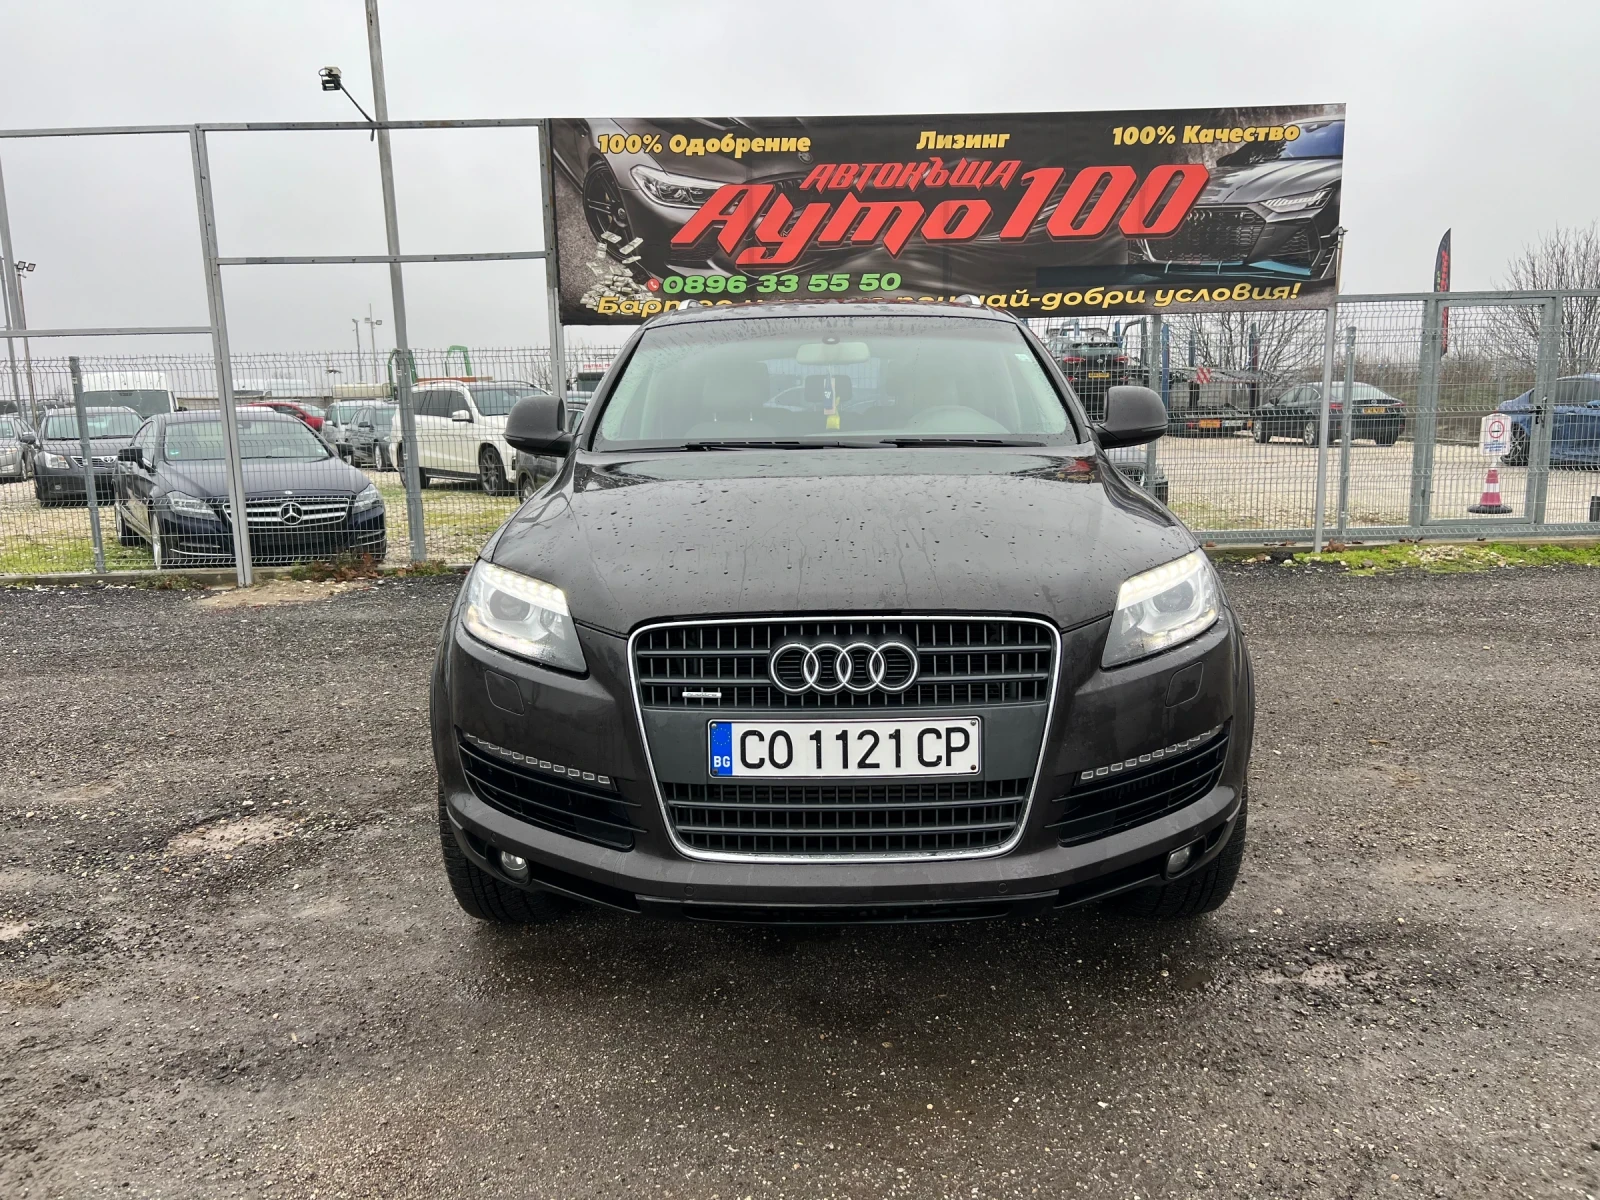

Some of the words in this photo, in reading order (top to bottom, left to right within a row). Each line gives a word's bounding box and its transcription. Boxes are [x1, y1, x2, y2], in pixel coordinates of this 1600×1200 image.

[599, 133, 662, 154] 100%
[669, 133, 811, 158] Одобрение
[916, 131, 1009, 150] Лизинг
[1112, 125, 1175, 145] 100%
[1182, 124, 1300, 144] Качество
[799, 157, 1021, 193] АВТОКЪЩА
[1000, 164, 1210, 241] 100
[663, 275, 747, 294] 0896
[756, 273, 799, 293] 33
[808, 273, 849, 293] 55
[859, 272, 902, 292] 50
[1153, 283, 1302, 307] условия!
[740, 729, 794, 770] CO
[809, 728, 902, 770] 1121
[917, 726, 970, 768] CP
[713, 755, 731, 768] BG
